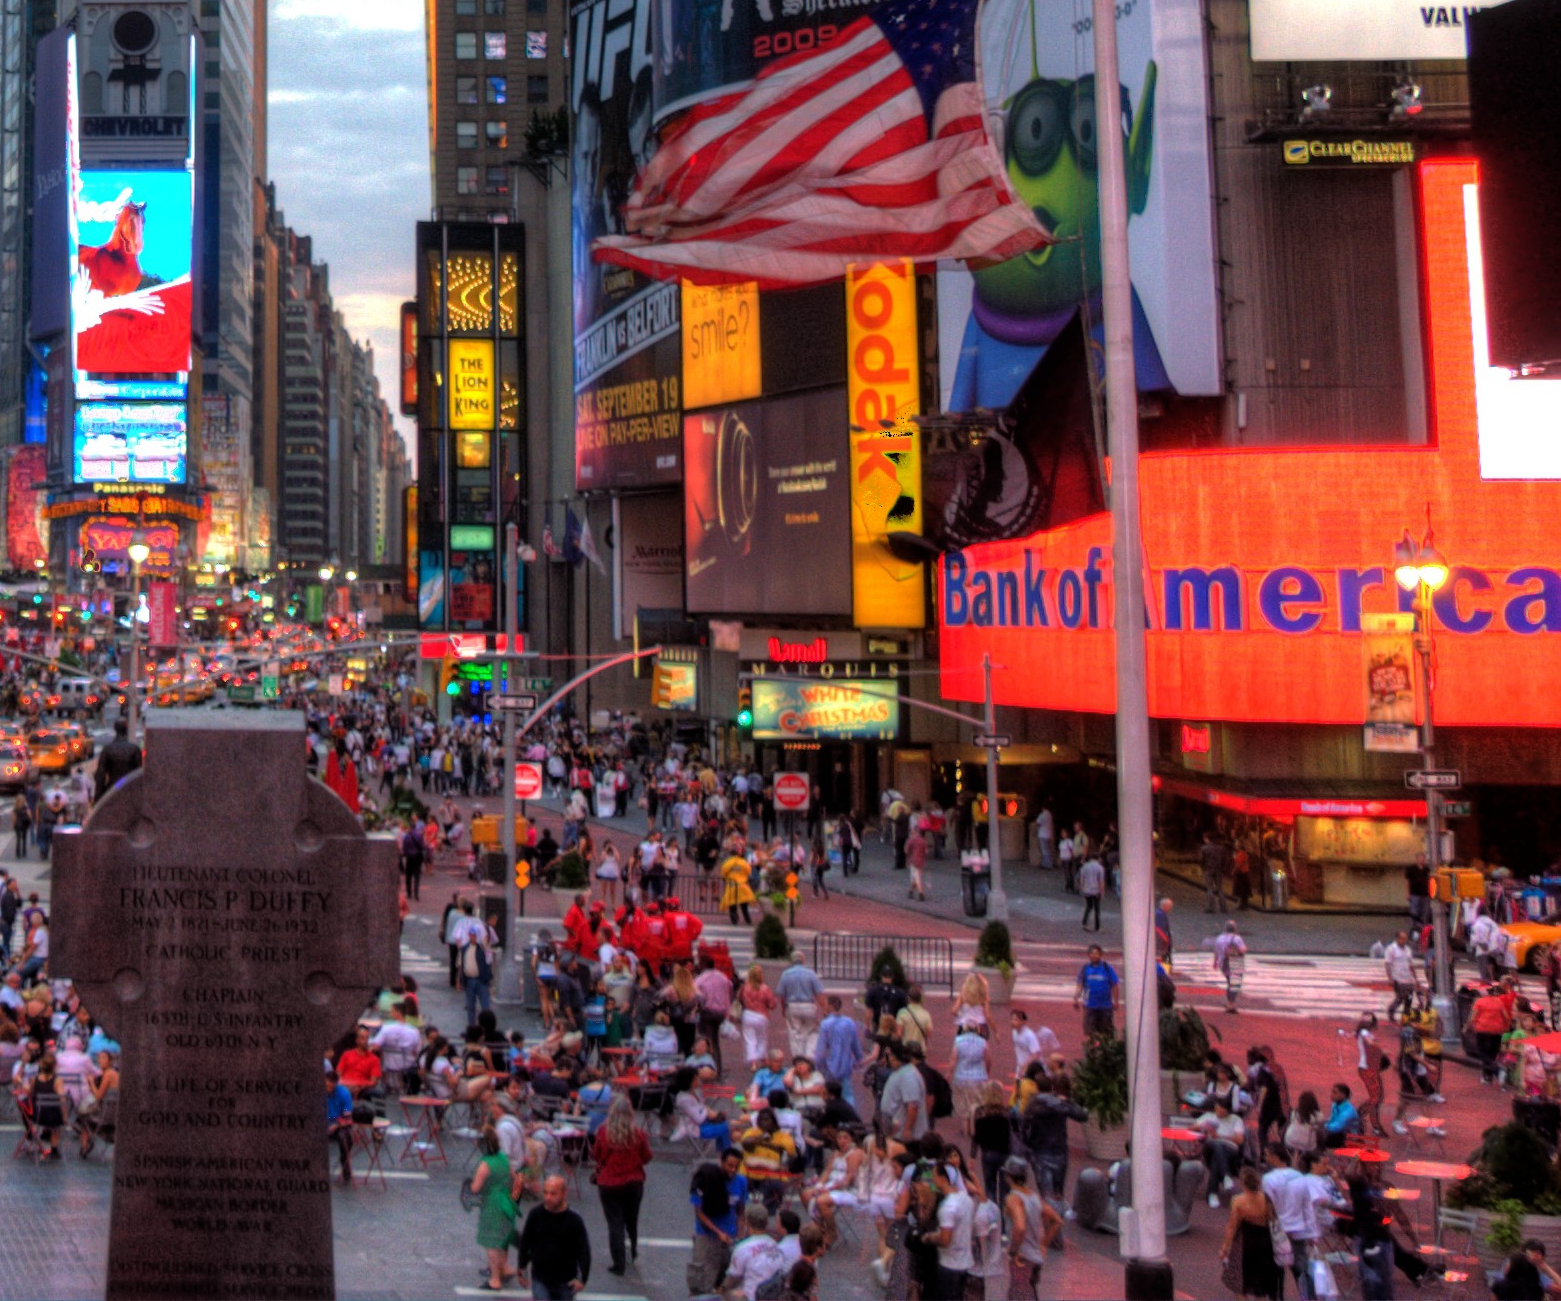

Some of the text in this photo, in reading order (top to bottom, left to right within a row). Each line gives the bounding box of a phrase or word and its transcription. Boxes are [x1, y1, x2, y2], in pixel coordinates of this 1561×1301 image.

[753, 23, 840, 59] 2009
[82, 117, 186, 137] CHEVROLET
[576, 319, 617, 383] FRANKLIN
[626, 287, 679, 347] BELFORT
[690, 300, 751, 360] smile?
[459, 357, 484, 371] THE
[454, 373, 488, 394] LION
[454, 396, 489, 418] KING
[596, 375, 679, 419] SEPTEMBER 19
[595, 422, 609, 447] ON
[609, 412, 681, 445] PAY-PER-VIEW
[93, 482, 166, 494] Panasonic
[943, 546, 1561, 635] Bank of merica
[751, 662, 899, 679] MARQUIS
[799, 684, 863, 704] WHITE
[779, 699, 889, 733] CHRISTMAS
[132, 866, 315, 886] LIEUTENANT COLONEL
[119, 887, 218, 911] FRANCIS
[249, 890, 332, 913] DUFFY
[145, 945, 302, 963] CATHOLIC PRIEST
[182, 987, 265, 1003] CHAPLAIN
[165, 1034, 200, 1048] OLD
[165, 1078, 199, 1093] LIFE
[205, 1078, 229, 1094] OF
[235, 1079, 303, 1095] SERVICE
[139, 1111, 309, 1129] GOD AND COUNTRY
[114, 1175, 149, 1190] NEW
[152, 1175, 195, 1191] YORK
[276, 1178, 331, 1193] GUARD
